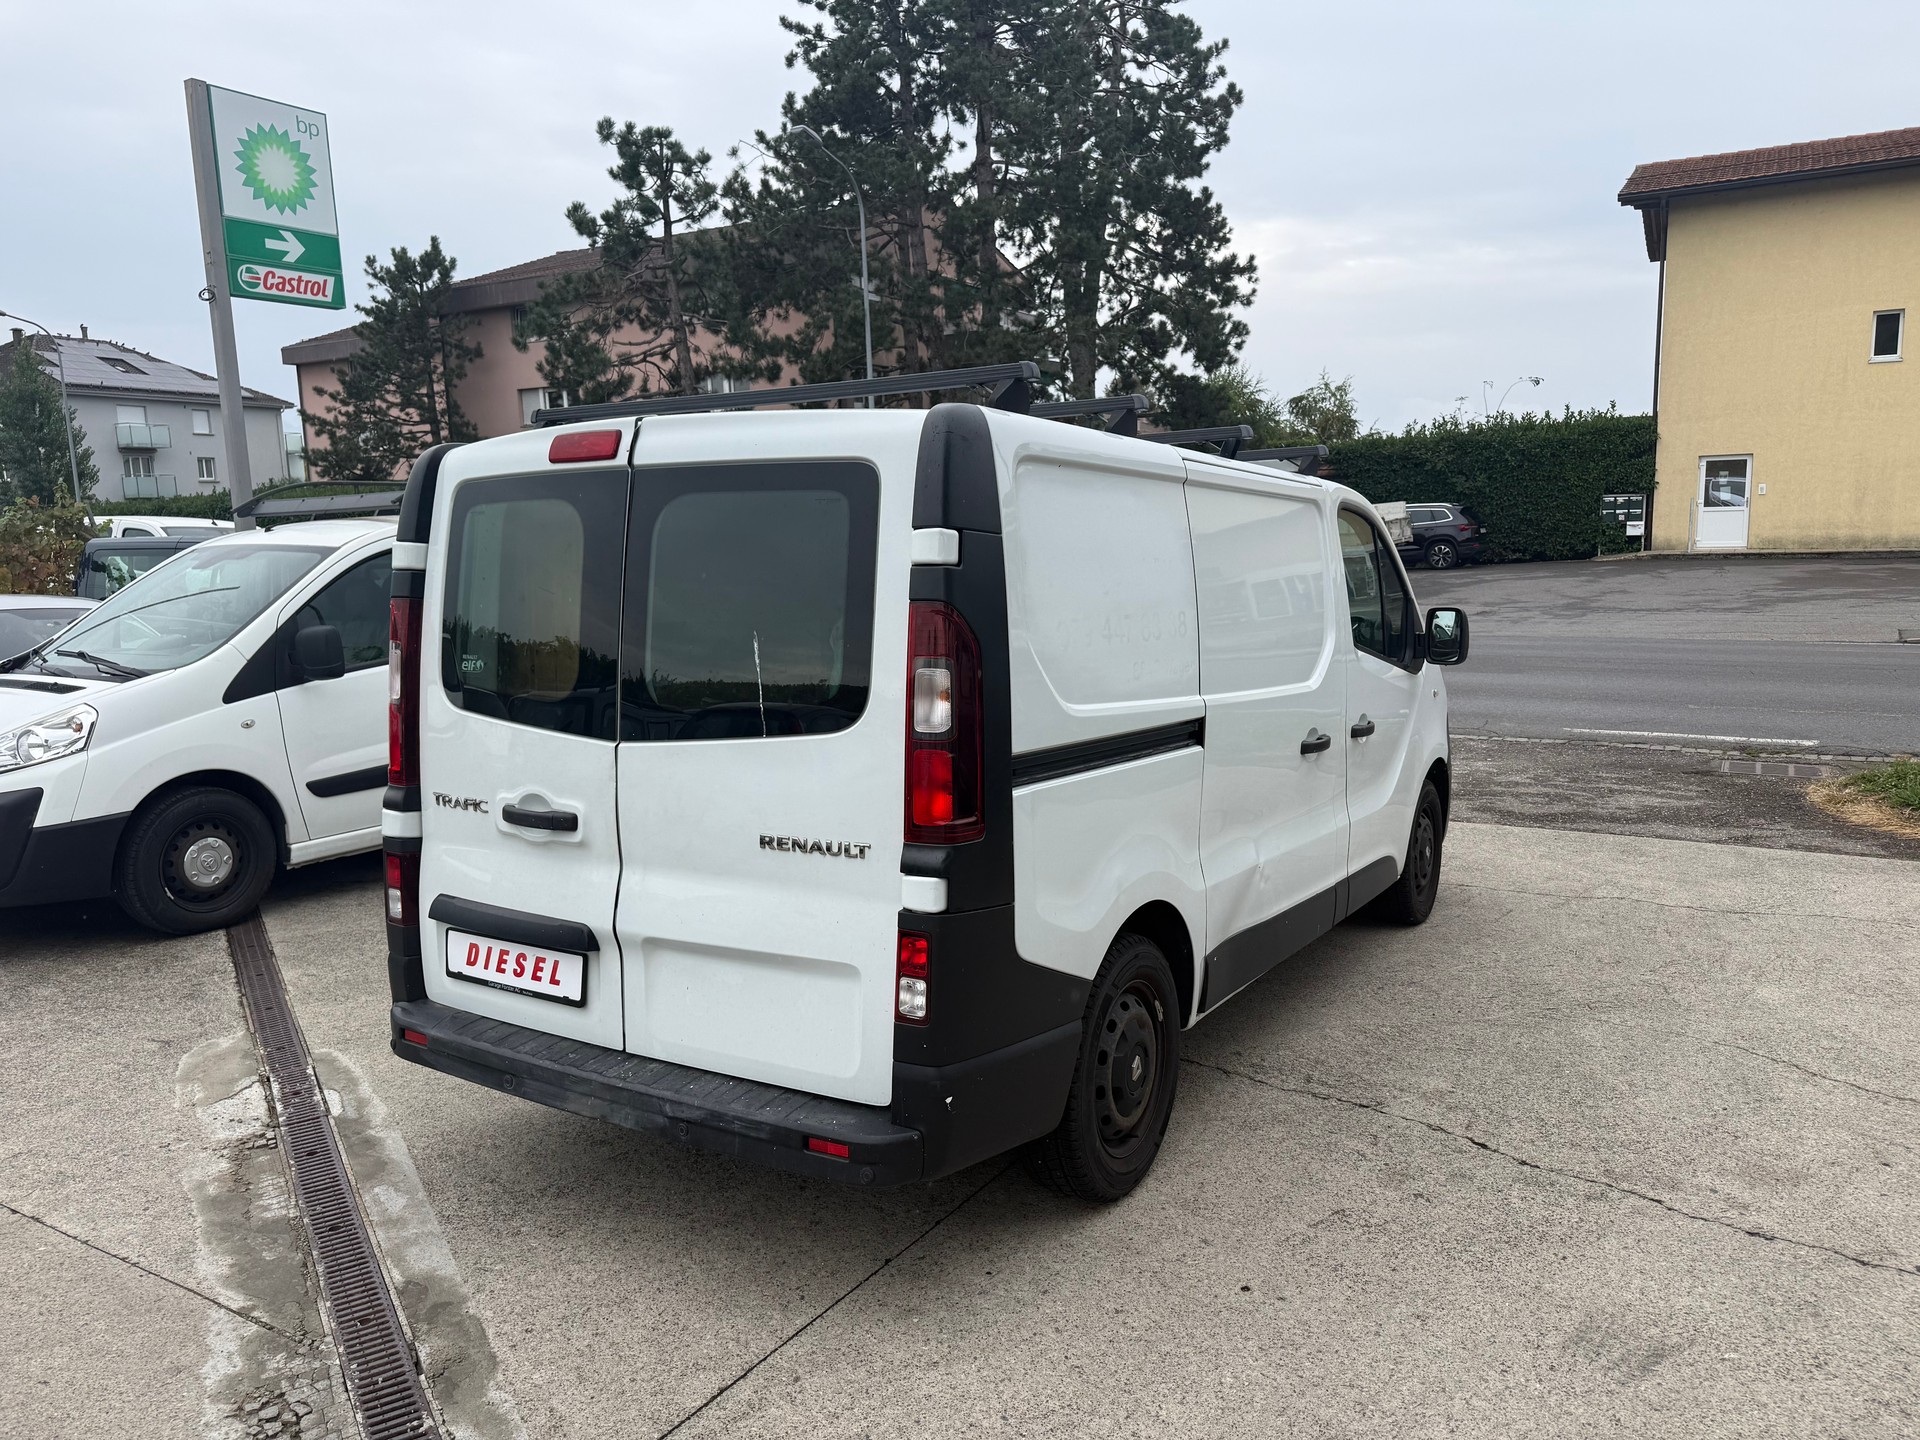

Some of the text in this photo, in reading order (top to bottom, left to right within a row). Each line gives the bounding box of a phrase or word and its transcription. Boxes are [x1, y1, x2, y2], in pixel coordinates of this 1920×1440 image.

[295, 114, 320, 140] bp
[262, 270, 328, 298] Castrol
[461, 660, 476, 671] elf
[432, 791, 489, 814] TRAFIC
[759, 833, 872, 860] RENAULT
[465, 942, 561, 986] DIESEL
